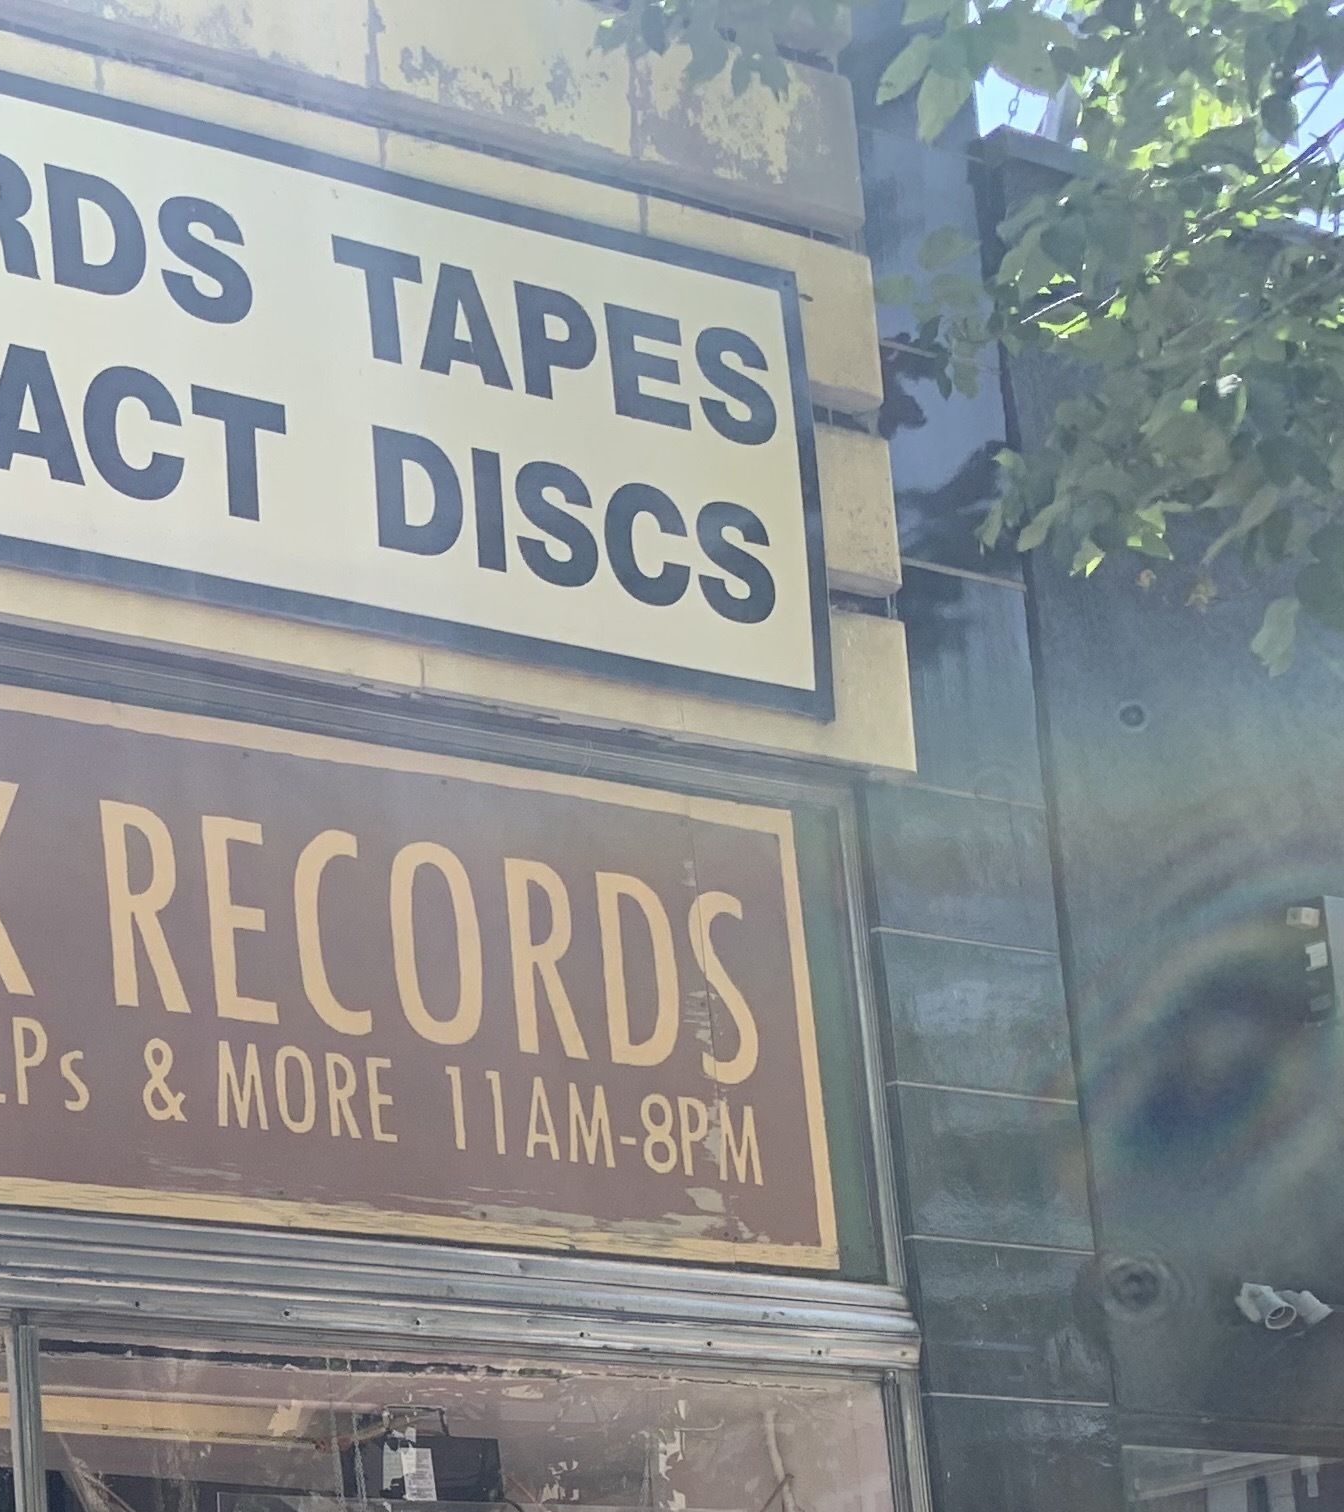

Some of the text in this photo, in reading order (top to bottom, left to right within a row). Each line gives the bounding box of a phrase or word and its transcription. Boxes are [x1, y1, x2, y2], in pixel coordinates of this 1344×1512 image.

[331, 233, 778, 447] TAPES
[371, 421, 777, 625] DISCS
[99, 798, 760, 1085] RECORDS
[142, 1036, 188, 1123] &
[217, 1040, 399, 1144] MORE
[444, 1062, 765, 1187] 11AM-8PM
